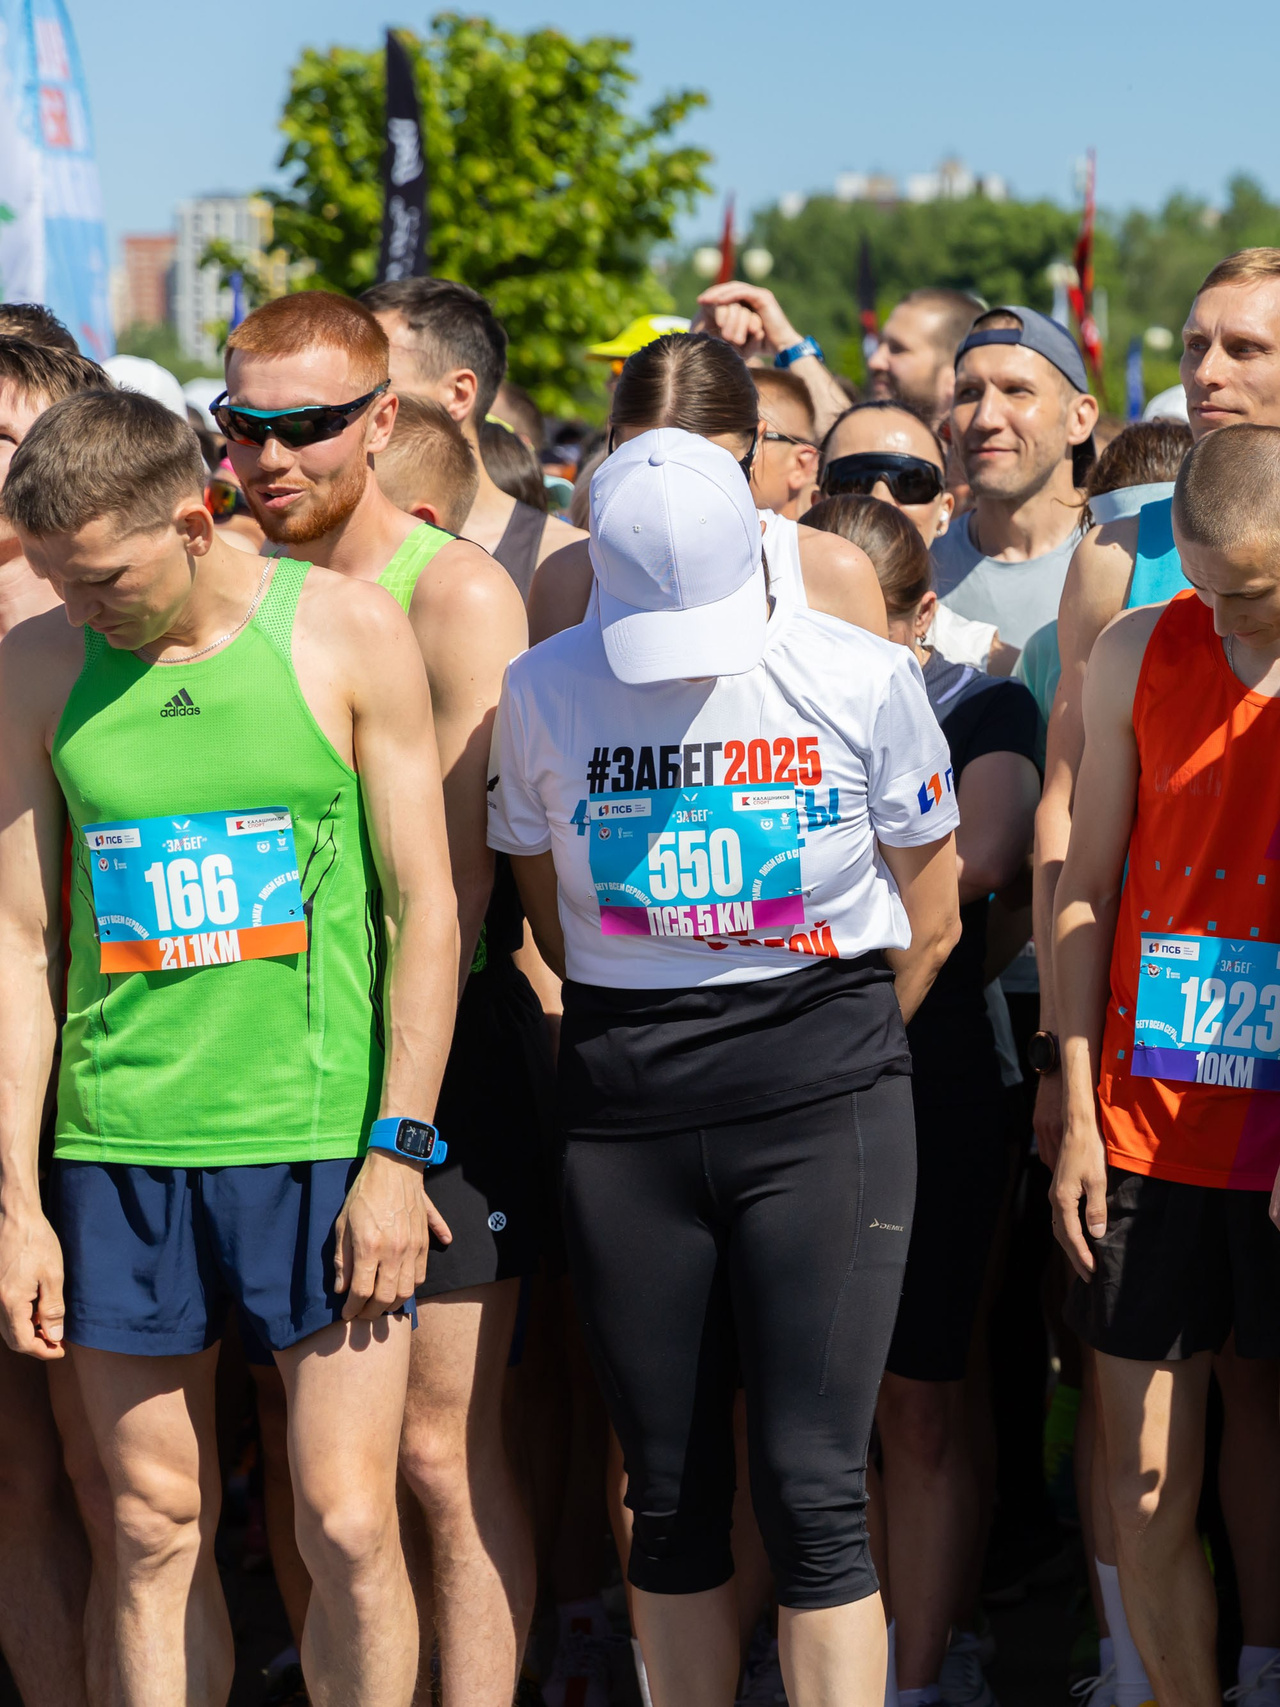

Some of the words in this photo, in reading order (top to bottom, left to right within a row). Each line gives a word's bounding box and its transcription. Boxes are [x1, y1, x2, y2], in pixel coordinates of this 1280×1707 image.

[160, 705, 201, 717] adidas
[587, 736, 823, 794] #ЗАБЕГ2025
[612, 805, 632, 814] ПСБ
[106, 835, 123, 845] ПСБ
[774, 852, 786, 863] БЕГ
[647, 828, 743, 901] 550
[144, 853, 240, 931] 166
[609, 882, 625, 892] ВСЕМ
[647, 905, 694, 937] ПСБ
[696, 904, 713, 936] 5
[1161, 945, 1181, 954] ПСБ
[1149, 1020, 1165, 1031] ВСЕМ
[879, 1222, 904, 1232] DEMIX
